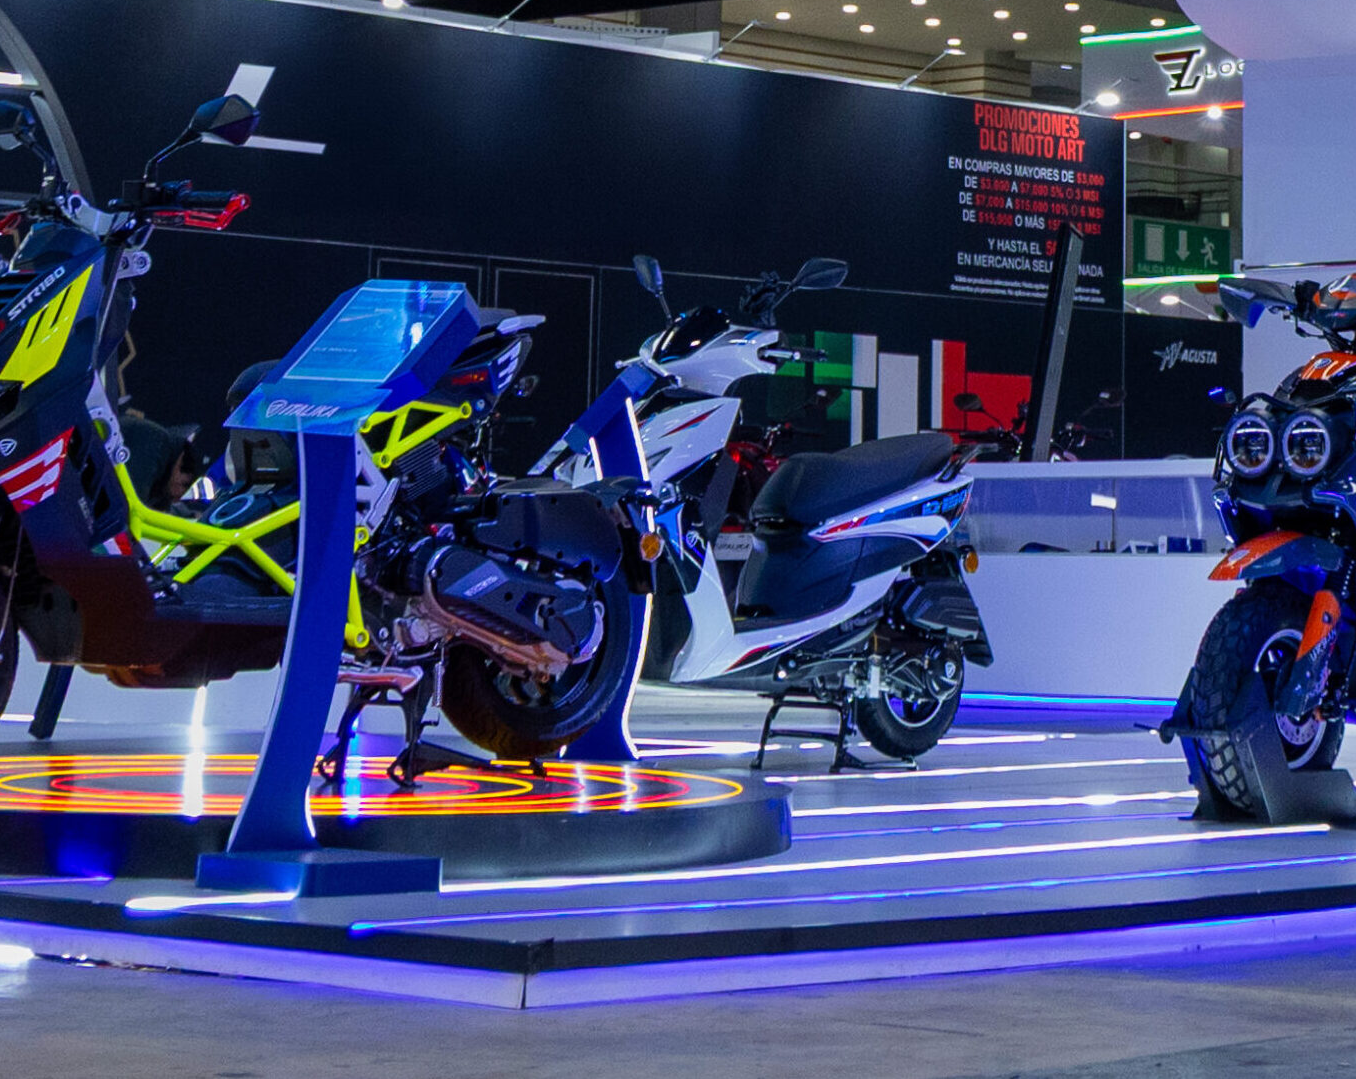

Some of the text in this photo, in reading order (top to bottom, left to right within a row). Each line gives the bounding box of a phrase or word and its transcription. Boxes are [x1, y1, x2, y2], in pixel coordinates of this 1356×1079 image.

[974, 103, 1081, 139] PROMOCIONES
[979, 128, 1086, 162] DLG MOTO ART
[948, 156, 962, 170] EN
[965, 158, 1012, 176] COMPRAS
[1014, 164, 1060, 181] MAYORES
[1061, 170, 1075, 183] DE
[964, 175, 978, 189] DE
[1010, 181, 1019, 193] A
[958, 191, 973, 205] DE
[1005, 197, 1013, 210] A
[962, 209, 976, 222] DE
[1014, 215, 1023, 228] O
[1024, 214, 1045, 230] MÁS
[988, 238, 996, 250] Y
[997, 238, 1029, 254] HASTA
[1030, 242, 1042, 256] EL
[957, 252, 972, 266] EN
[973, 254, 1031, 272] MERCANCÍA
[1181, 348, 1218, 365] AGUSTA
